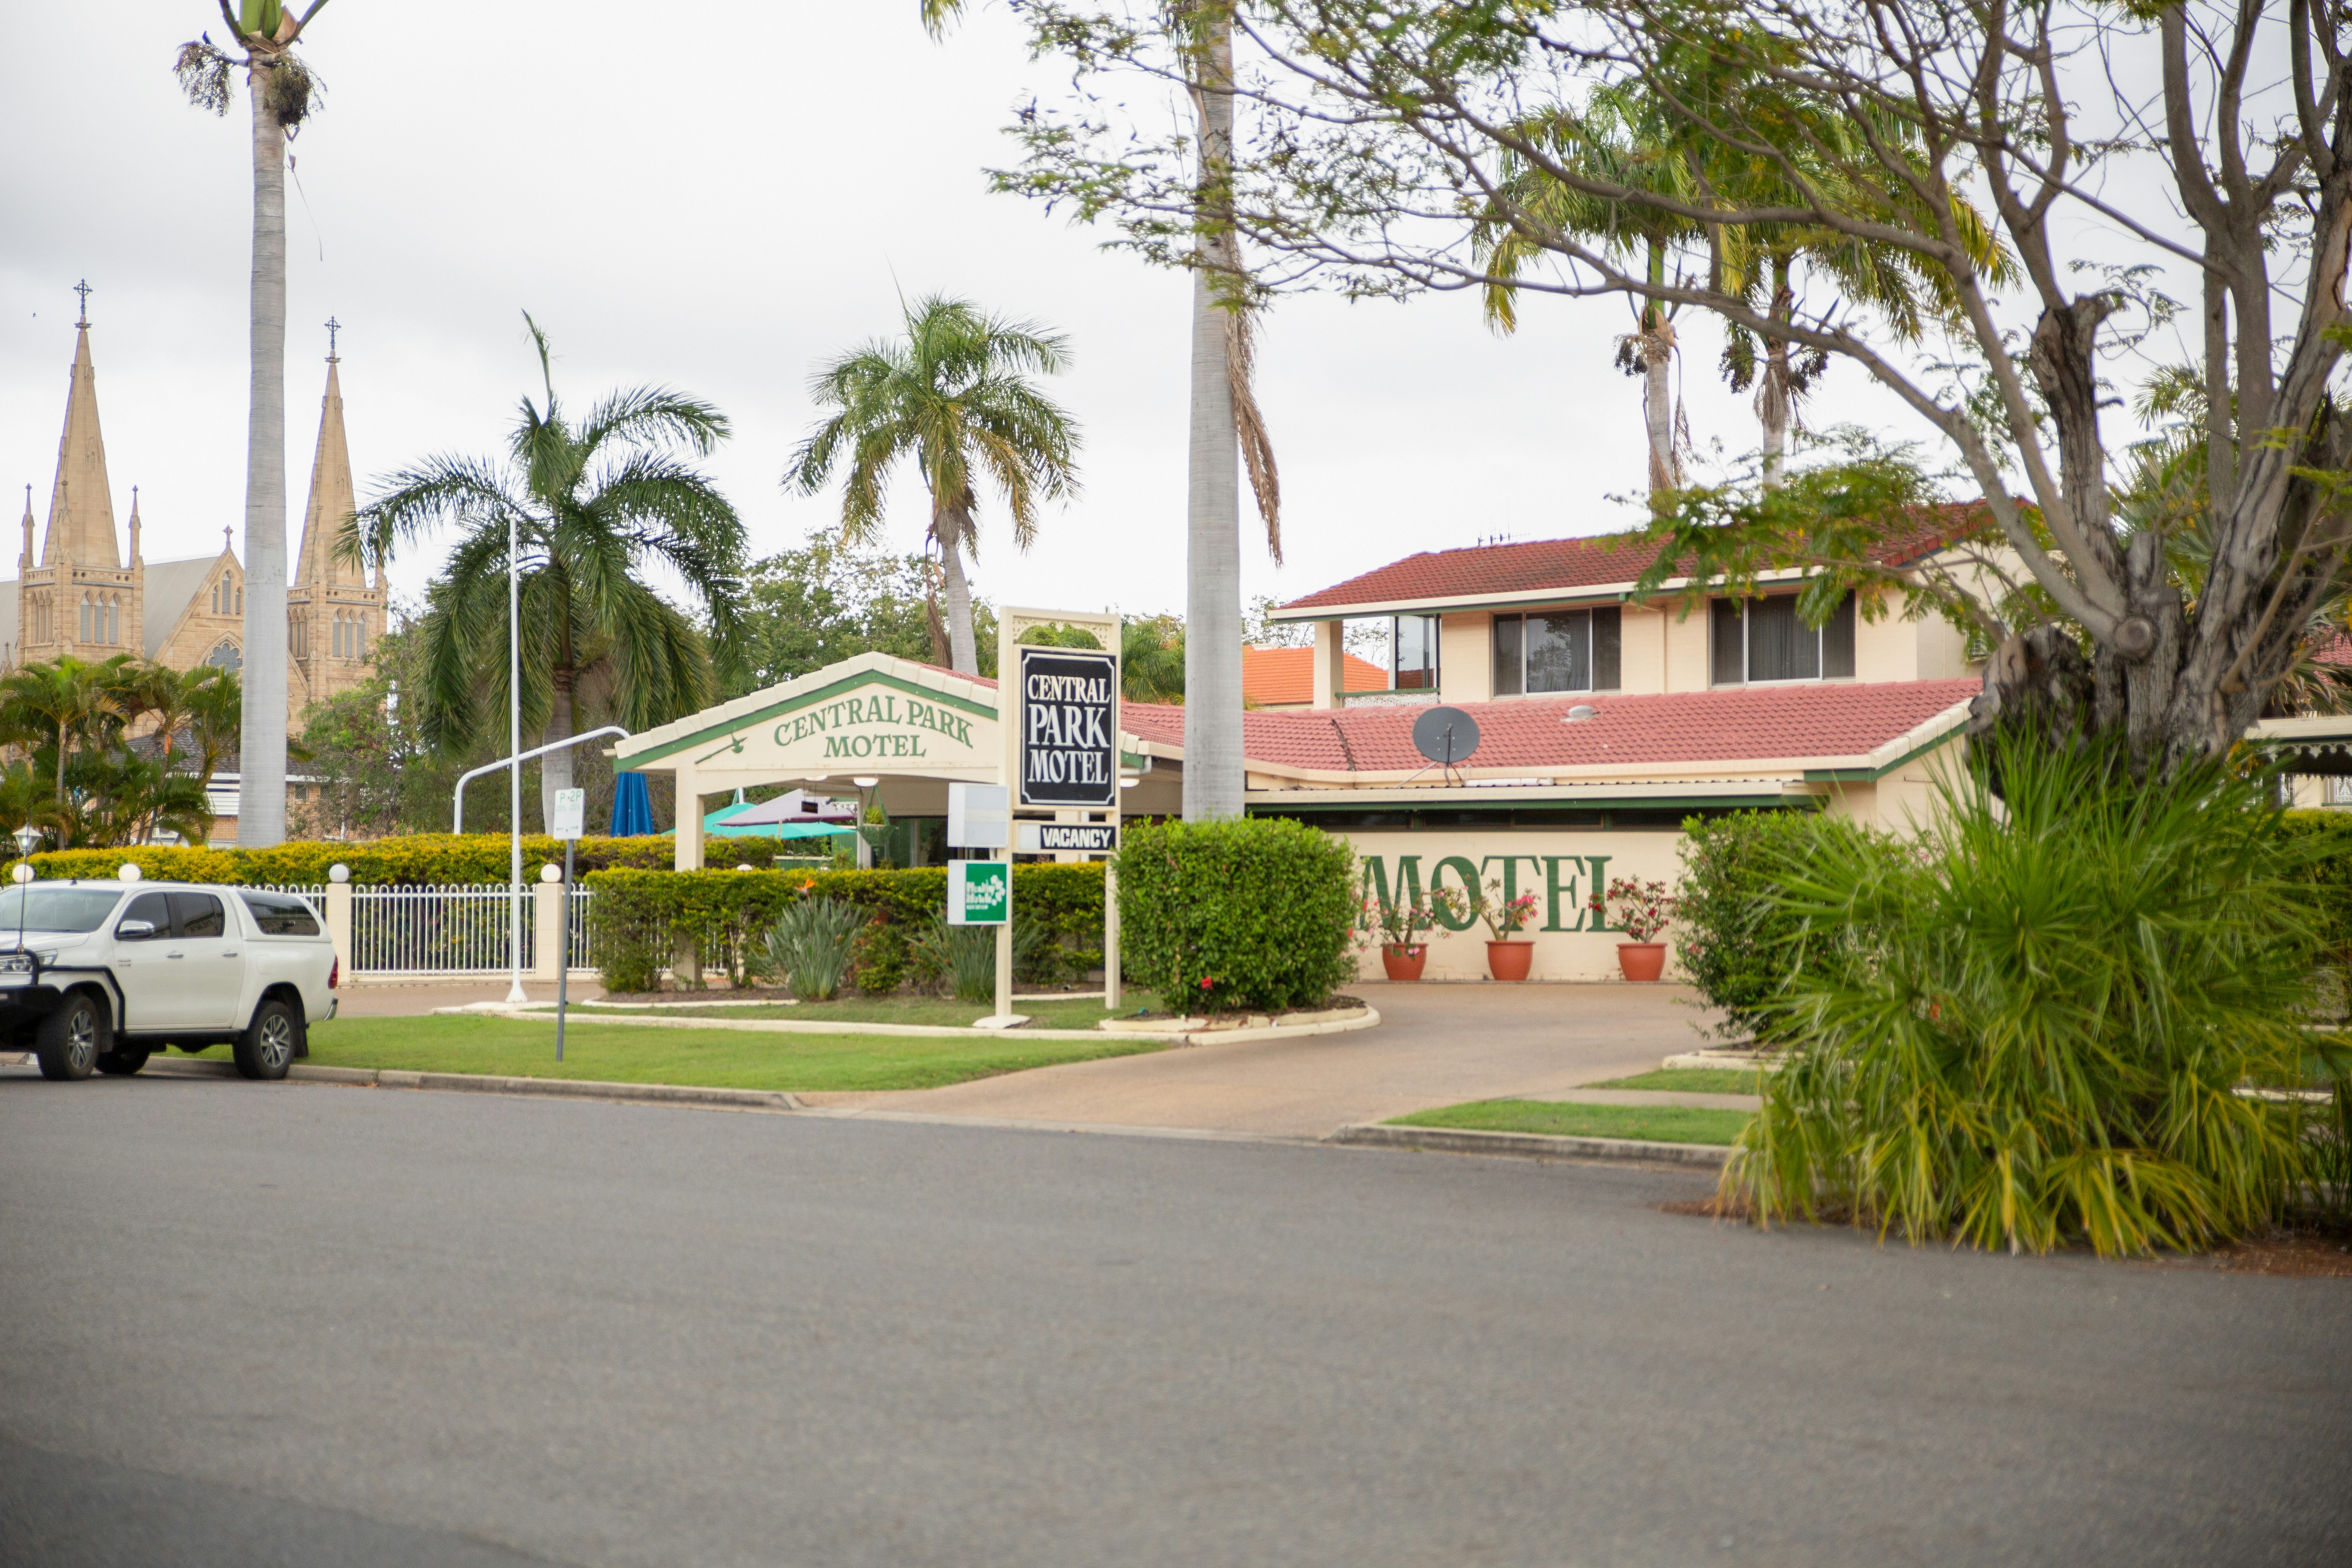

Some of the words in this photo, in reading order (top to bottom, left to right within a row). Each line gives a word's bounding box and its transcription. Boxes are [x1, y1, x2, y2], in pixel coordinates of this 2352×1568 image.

[1027, 674, 1110, 704] CENTRAL
[774, 695, 902, 746] CENTRAL
[906, 699, 973, 749] PARK
[1028, 704, 1110, 749] PARK
[823, 734, 927, 757] MOTEL
[1027, 749, 1108, 784] MOTEL
[570, 790, 581, 802] 2P
[1042, 828, 1111, 848] VACANCY
[1356, 855, 1634, 932] MOTEL
